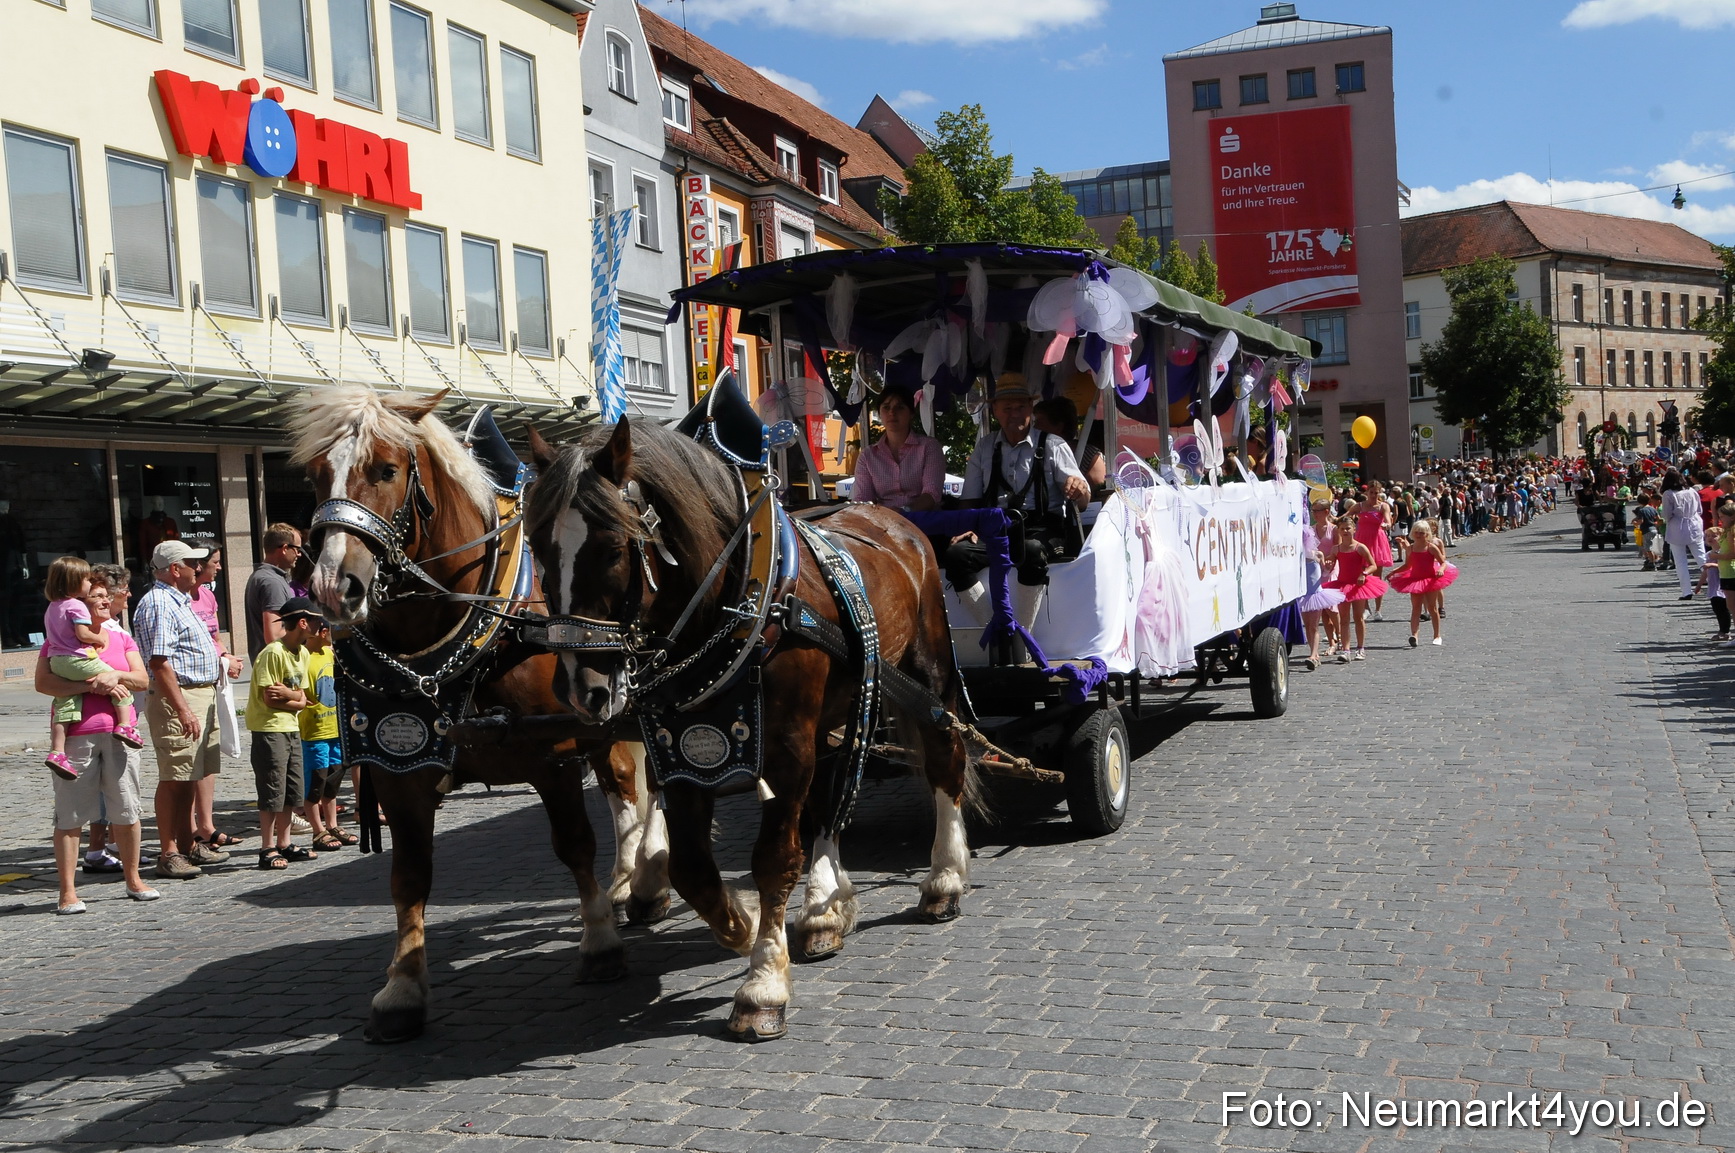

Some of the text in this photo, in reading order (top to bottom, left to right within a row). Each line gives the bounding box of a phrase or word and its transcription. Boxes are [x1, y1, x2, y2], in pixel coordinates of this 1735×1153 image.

[154, 69, 422, 211] WÖHRL
[1221, 162, 1272, 180] Danke
[1221, 181, 1305, 197] für Ihr Vertrauen
[1222, 195, 1298, 210] und Ihre Treue.
[1265, 228, 1314, 251] 175
[1268, 248, 1314, 263] JAHRE
